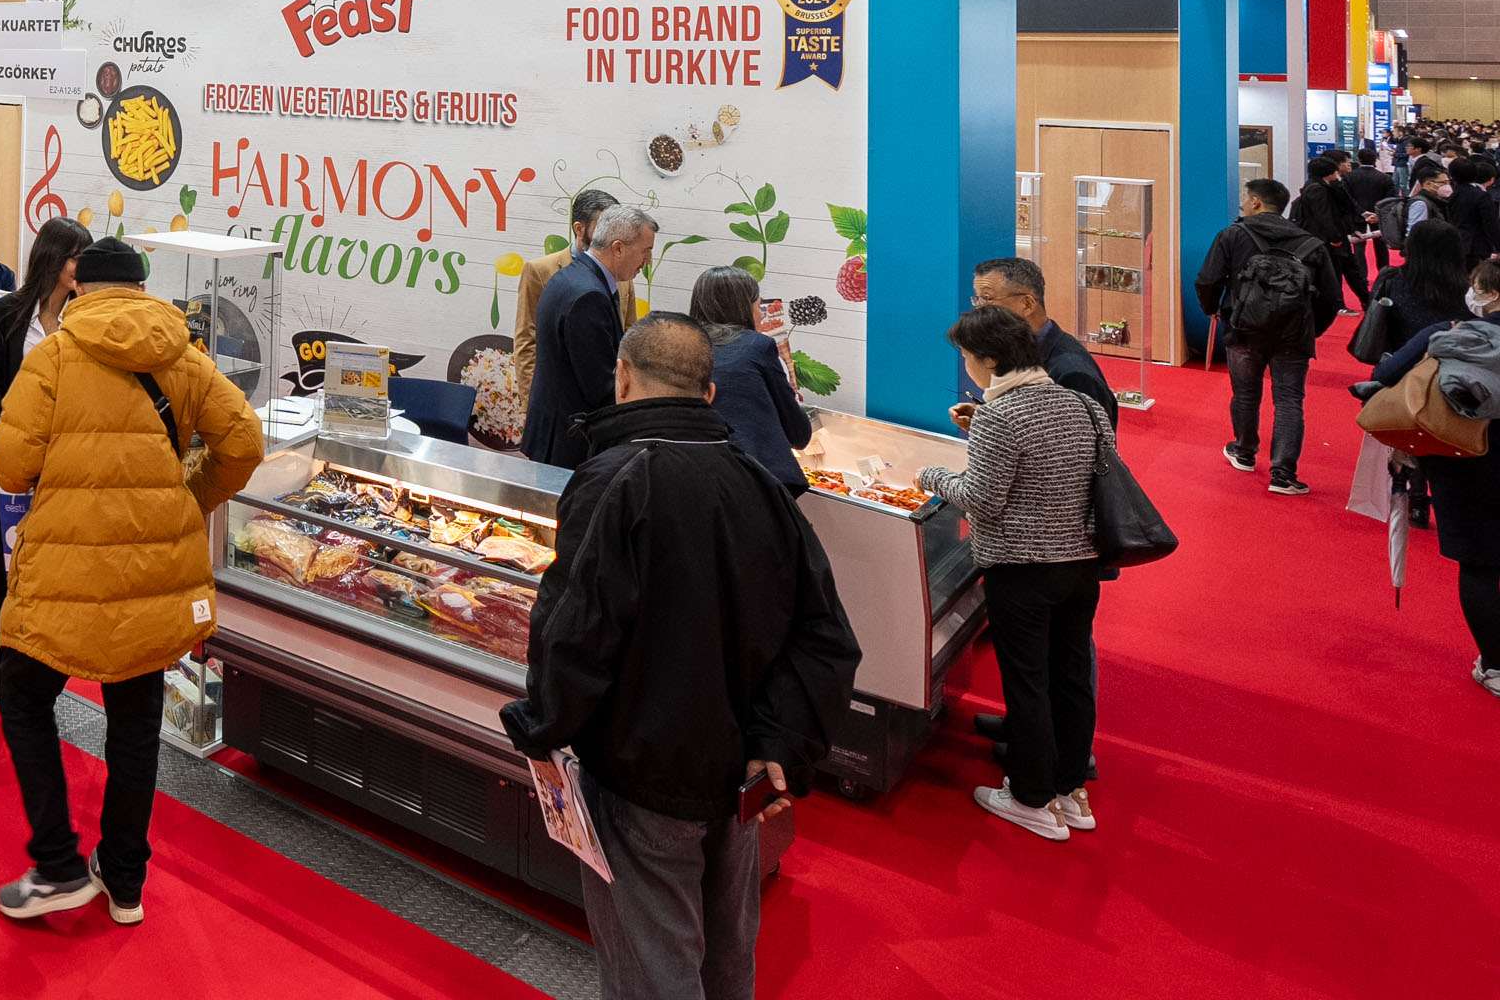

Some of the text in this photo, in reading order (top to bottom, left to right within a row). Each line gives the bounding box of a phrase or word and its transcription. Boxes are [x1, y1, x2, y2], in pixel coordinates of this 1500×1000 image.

[566, 5, 761, 41] FOOD BRAND
[794, 9, 834, 20] BRUSSELS
[113, 31, 187, 59] CHURROS
[787, 36, 841, 52] TASTE
[127, 58, 168, 78] potato
[586, 49, 761, 86] IN TURKIYE
[49, 85, 82, 96] E2-A12-65
[205, 84, 518, 124] FROZEN VEGETABLES & FRUITS
[212, 138, 536, 242] HARMONY
[262, 214, 466, 295] flavors
[232, 284, 258, 313] ring
